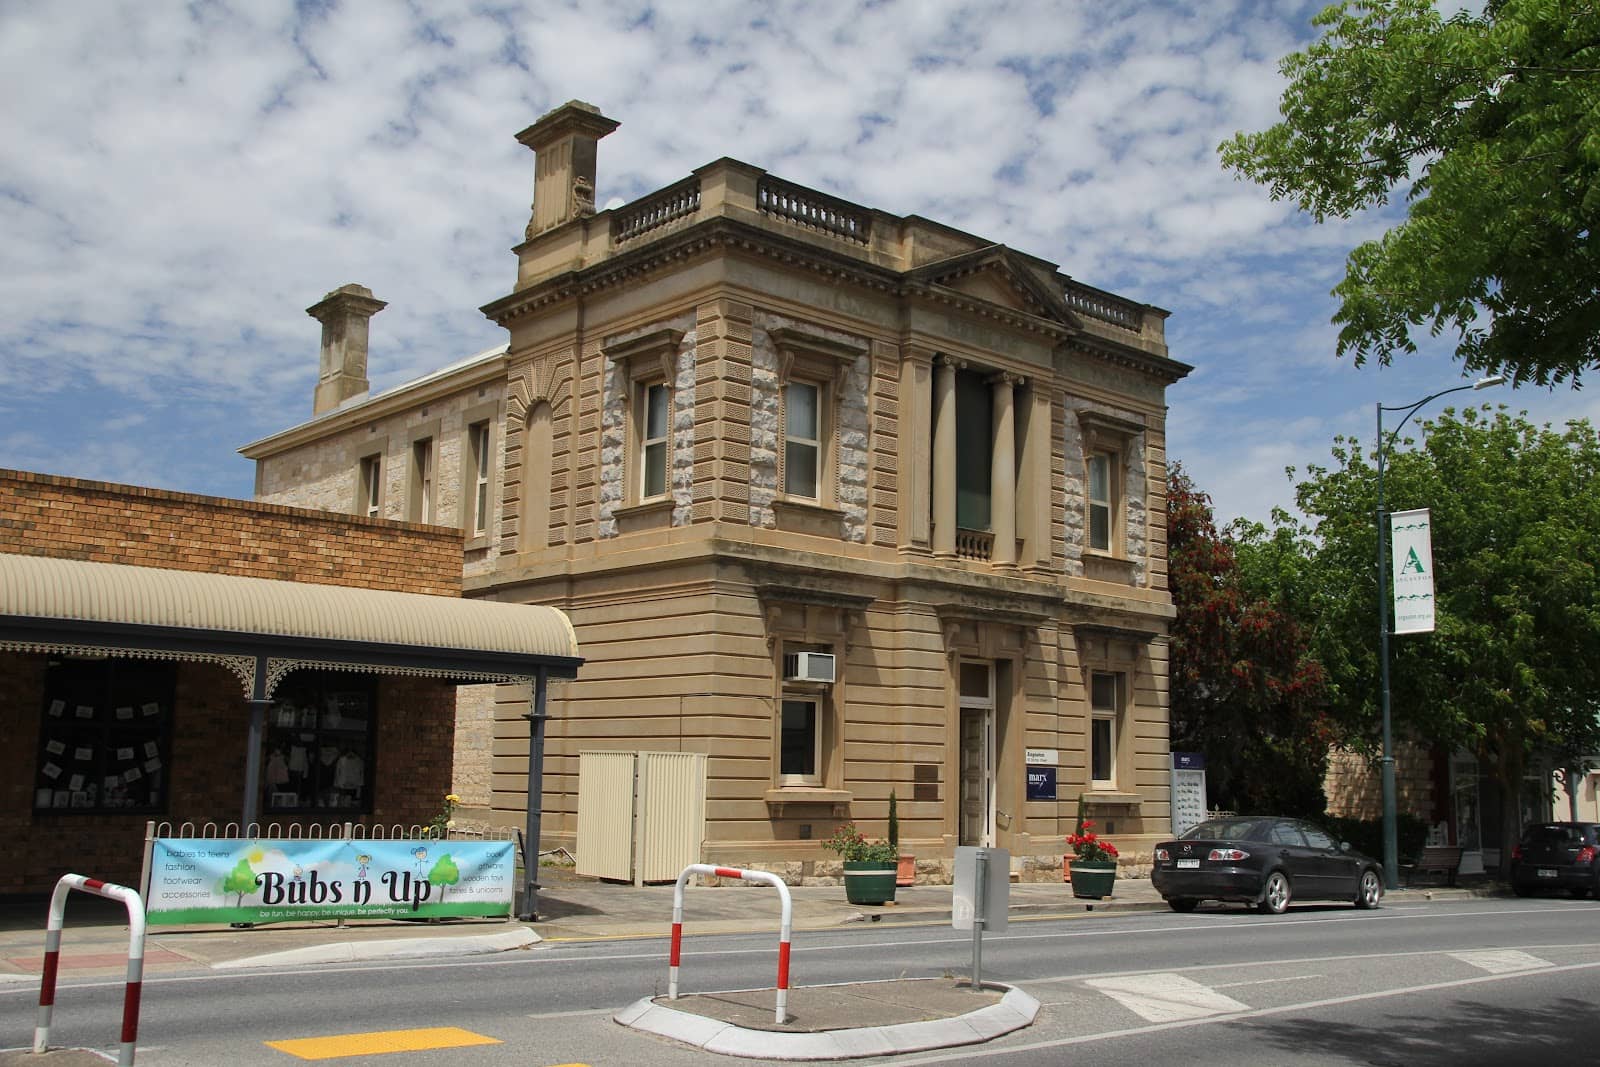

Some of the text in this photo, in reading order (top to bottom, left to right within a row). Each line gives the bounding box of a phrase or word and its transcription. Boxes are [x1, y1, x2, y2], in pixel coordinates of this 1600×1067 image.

[166, 849, 196, 857] babies
[165, 863, 196, 872] fashion
[162, 891, 210, 899] accessories
[255, 870, 432, 912] Bubs n Up
[368, 908, 394, 916] perfectly
